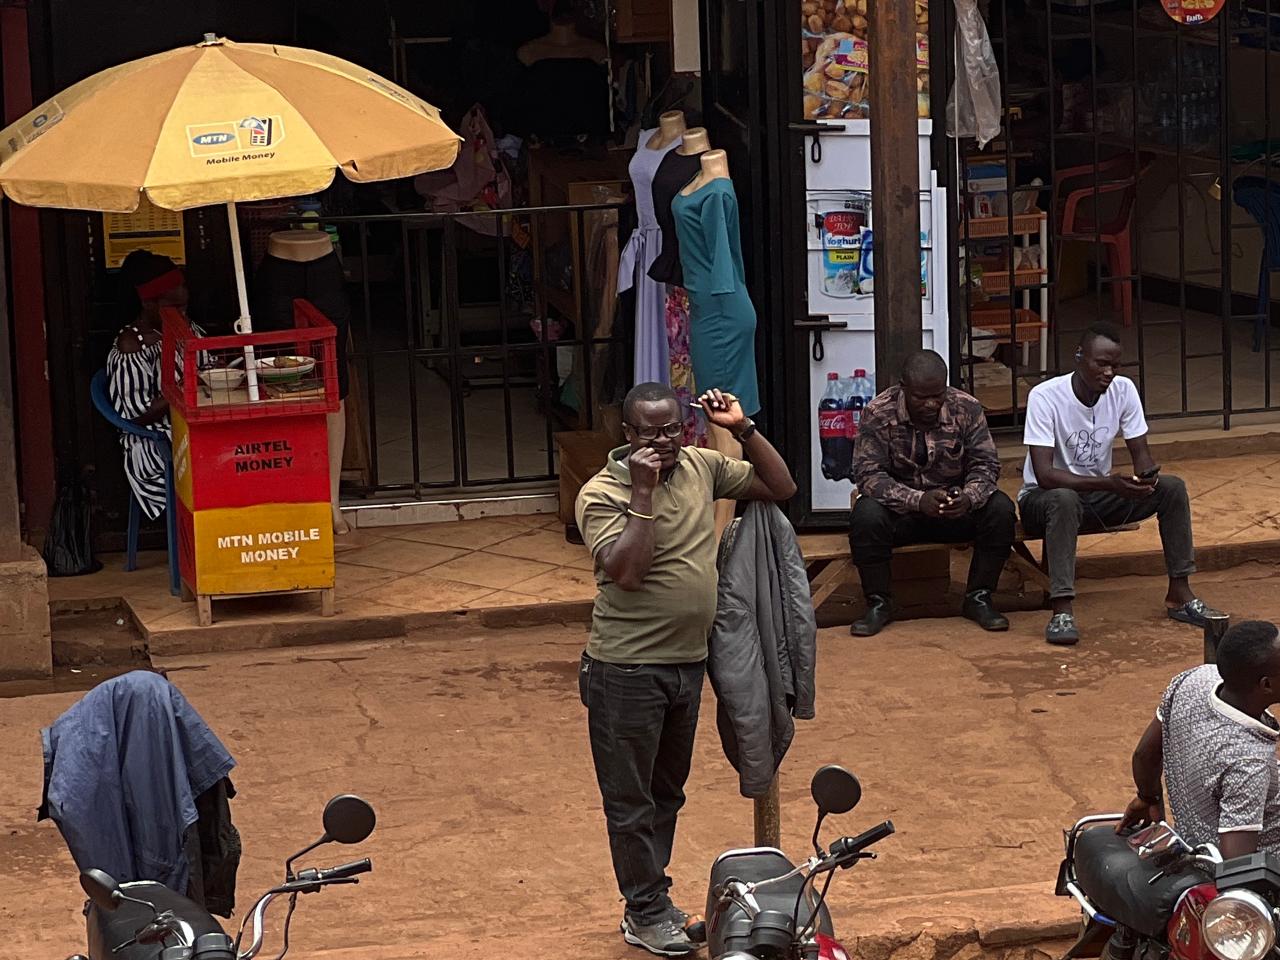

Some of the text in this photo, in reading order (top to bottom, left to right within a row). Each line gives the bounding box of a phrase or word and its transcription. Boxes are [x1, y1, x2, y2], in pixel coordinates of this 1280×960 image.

[200, 134, 228, 144] MTN
[206, 152, 275, 165] Mobile Money
[234, 440, 293, 456] AIRTEL
[235, 456, 294, 473] MONEY
[217, 528, 321, 549] MTN MOBILE
[240, 547, 300, 564] MONEY
